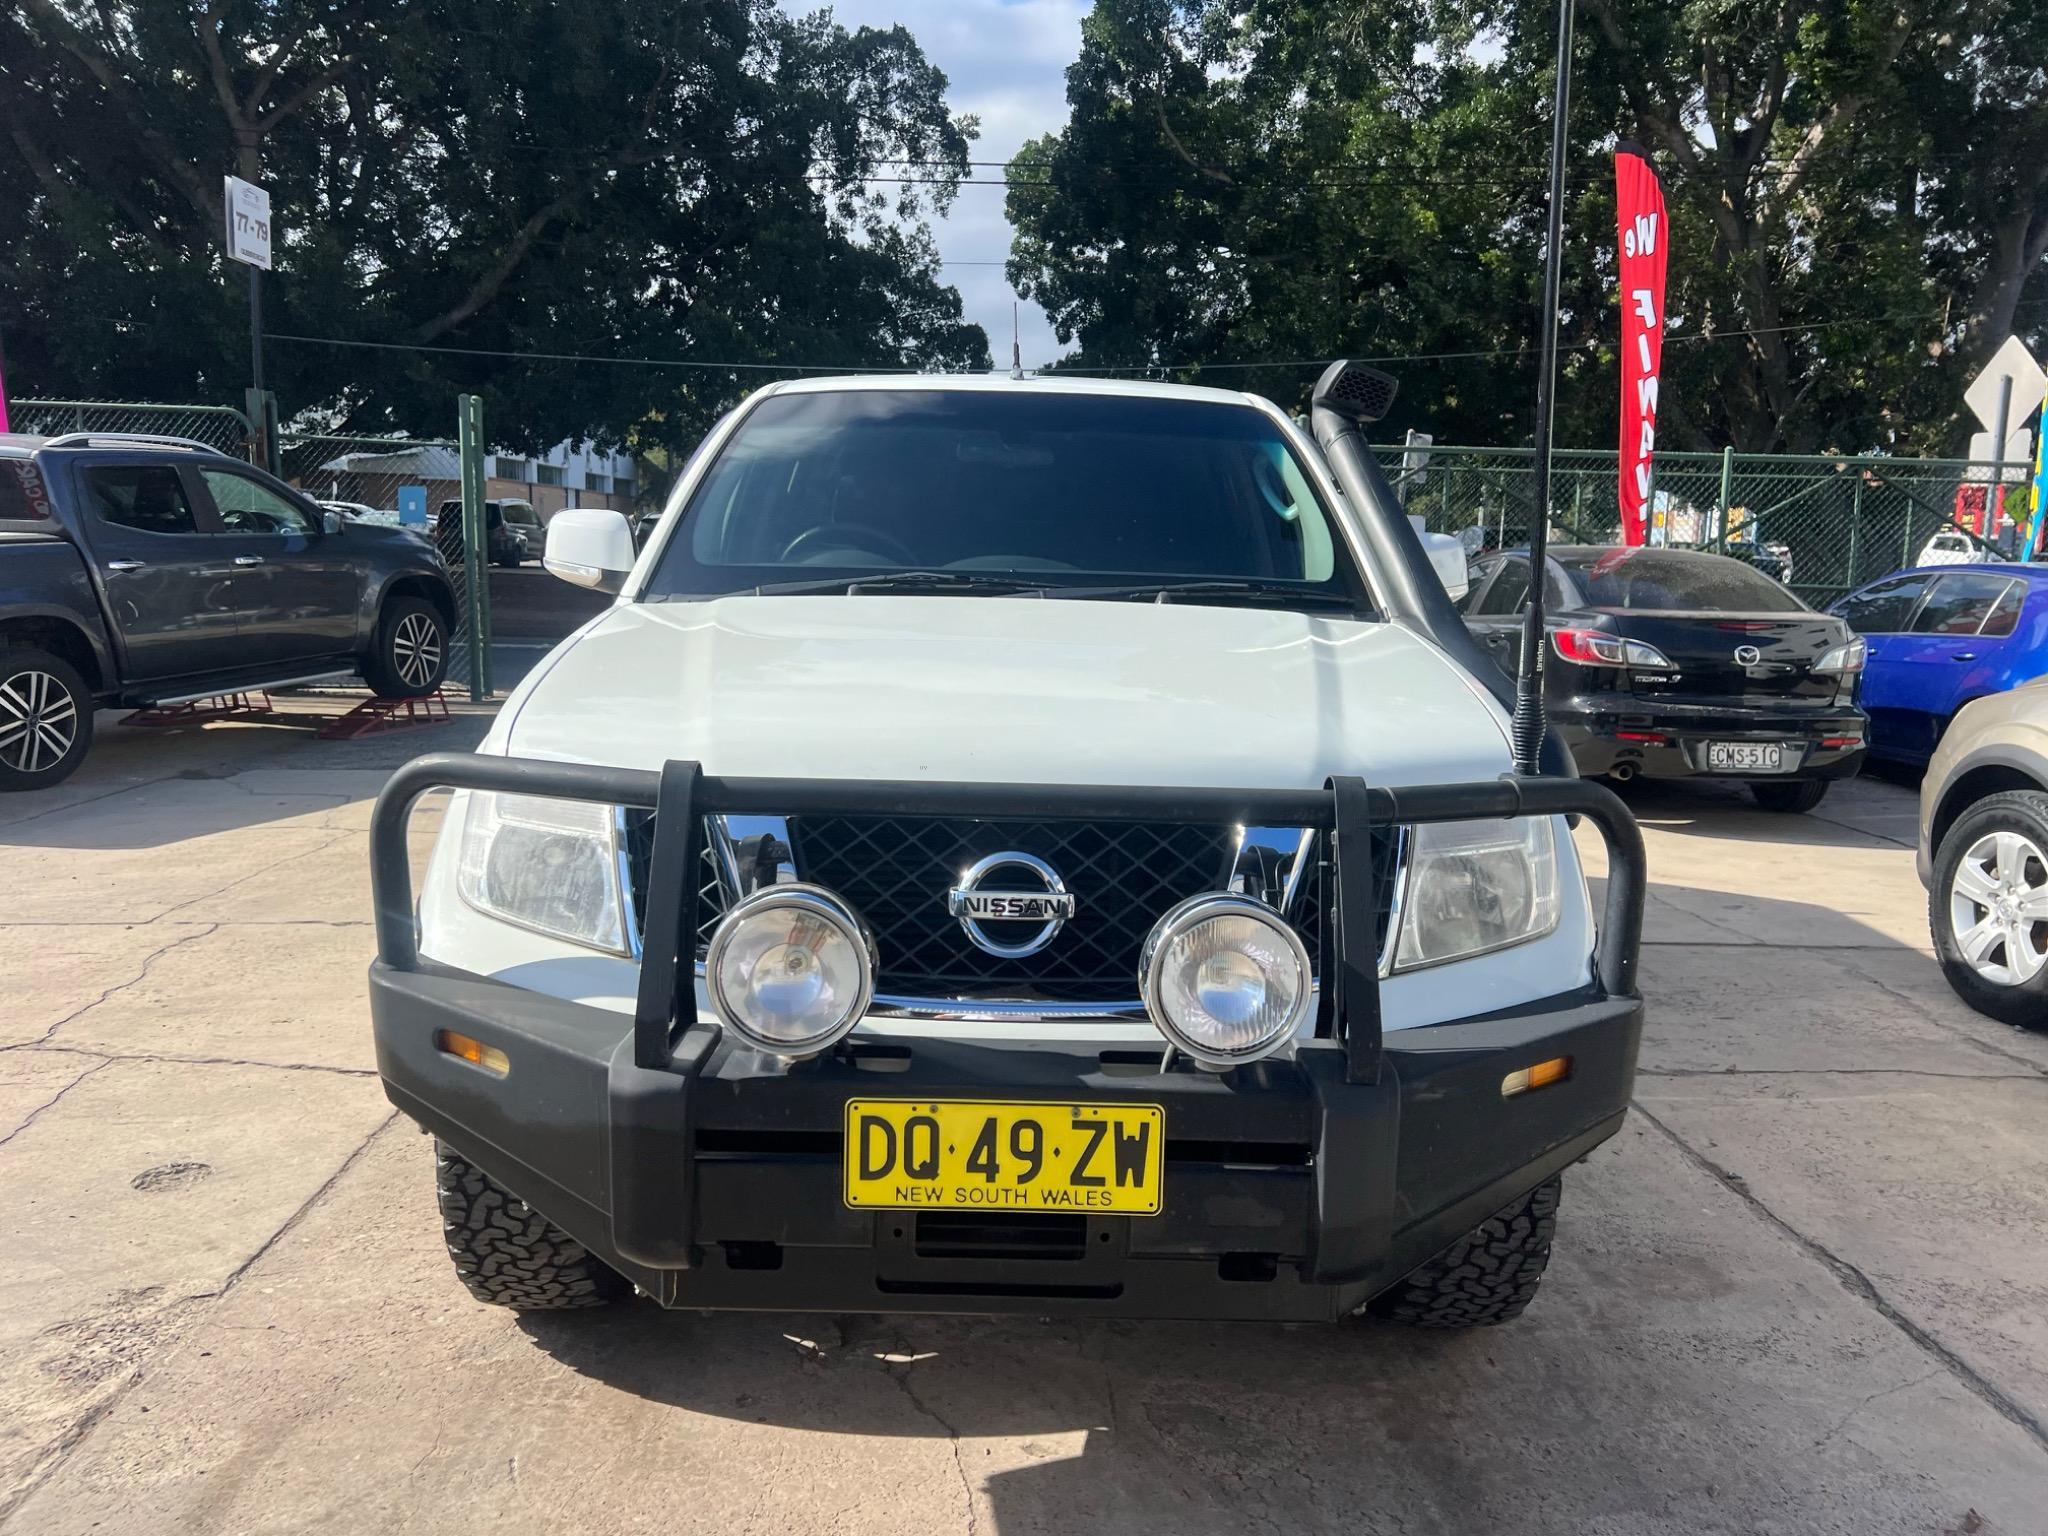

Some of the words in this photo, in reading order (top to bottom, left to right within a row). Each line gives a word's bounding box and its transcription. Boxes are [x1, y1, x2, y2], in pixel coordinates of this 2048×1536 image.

[1536, 639, 1545, 672] Uniden
[962, 897, 1062, 914] NISSAN
[895, 1186, 944, 1202] NEW
[955, 1187, 1028, 1204] SOUTH
[1041, 1189, 1113, 1206] WALES
